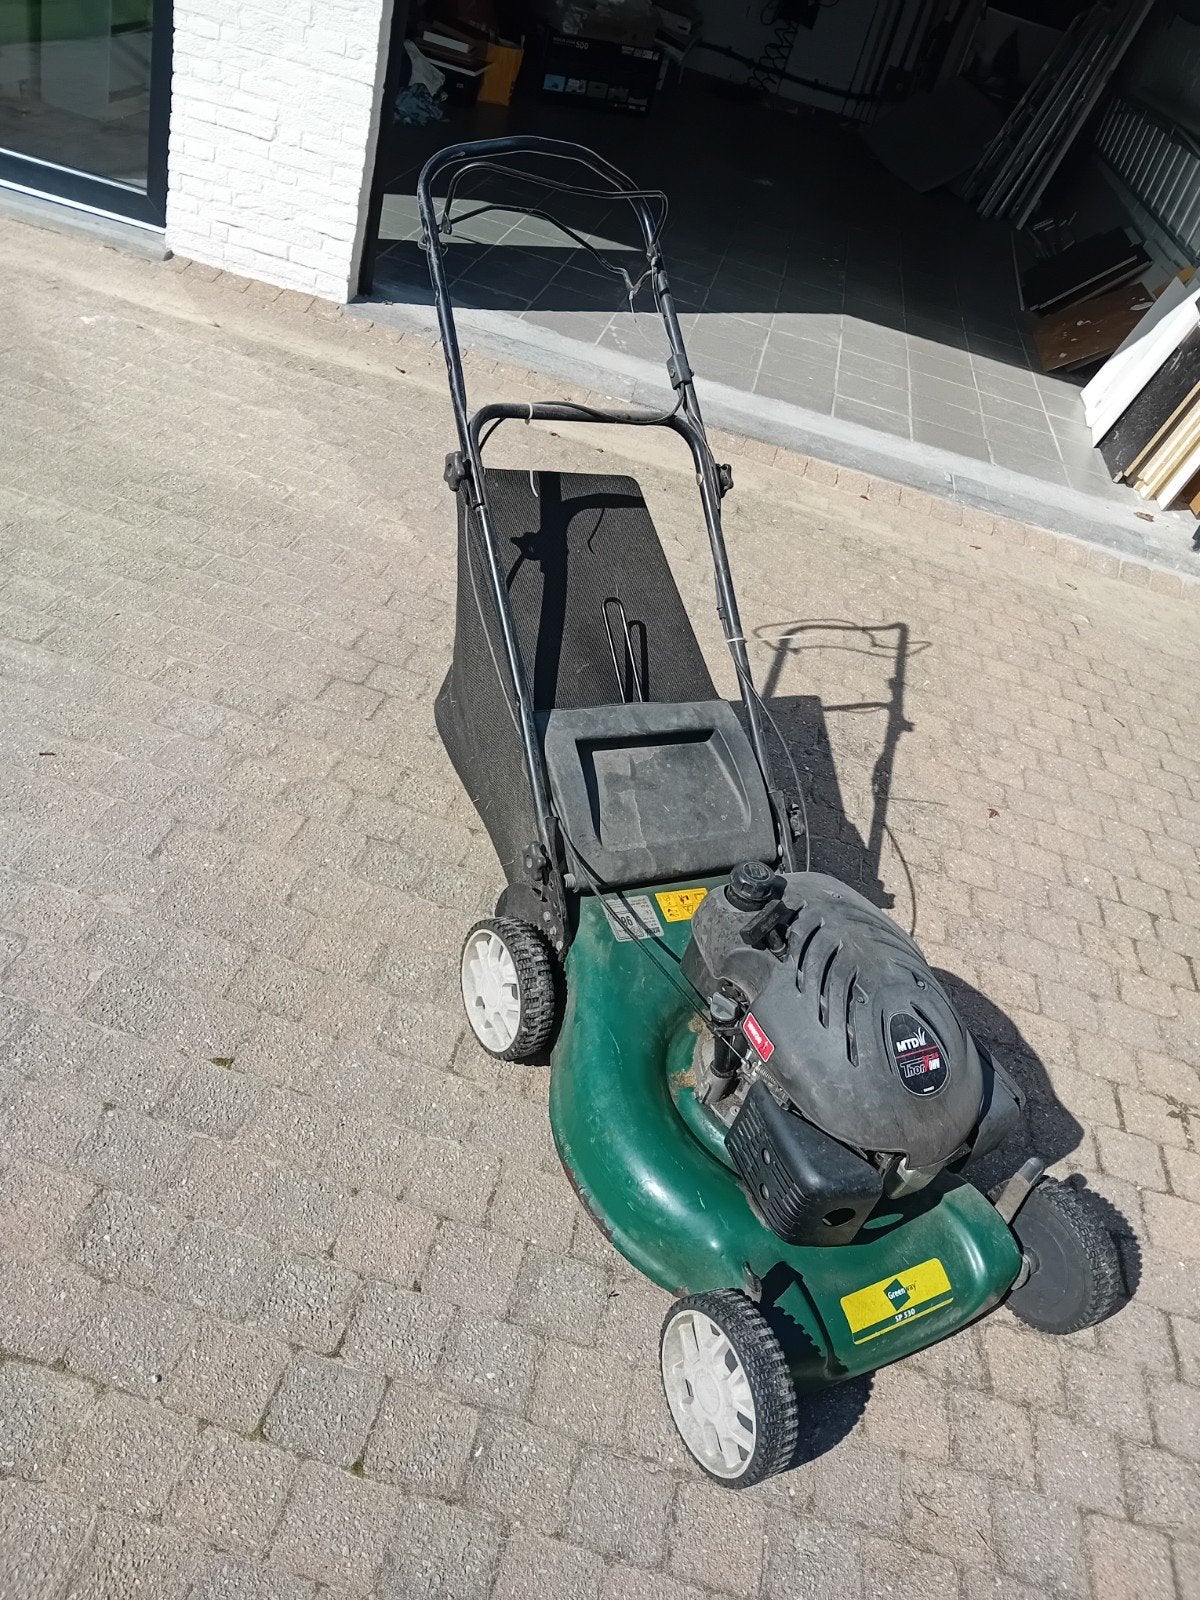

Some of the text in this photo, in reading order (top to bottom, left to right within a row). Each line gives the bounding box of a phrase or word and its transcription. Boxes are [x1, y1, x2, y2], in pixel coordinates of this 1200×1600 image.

[896, 1037, 919, 1052] MTD
[887, 1282, 917, 1300] Greenway
[895, 1308, 916, 1322] SP 530
